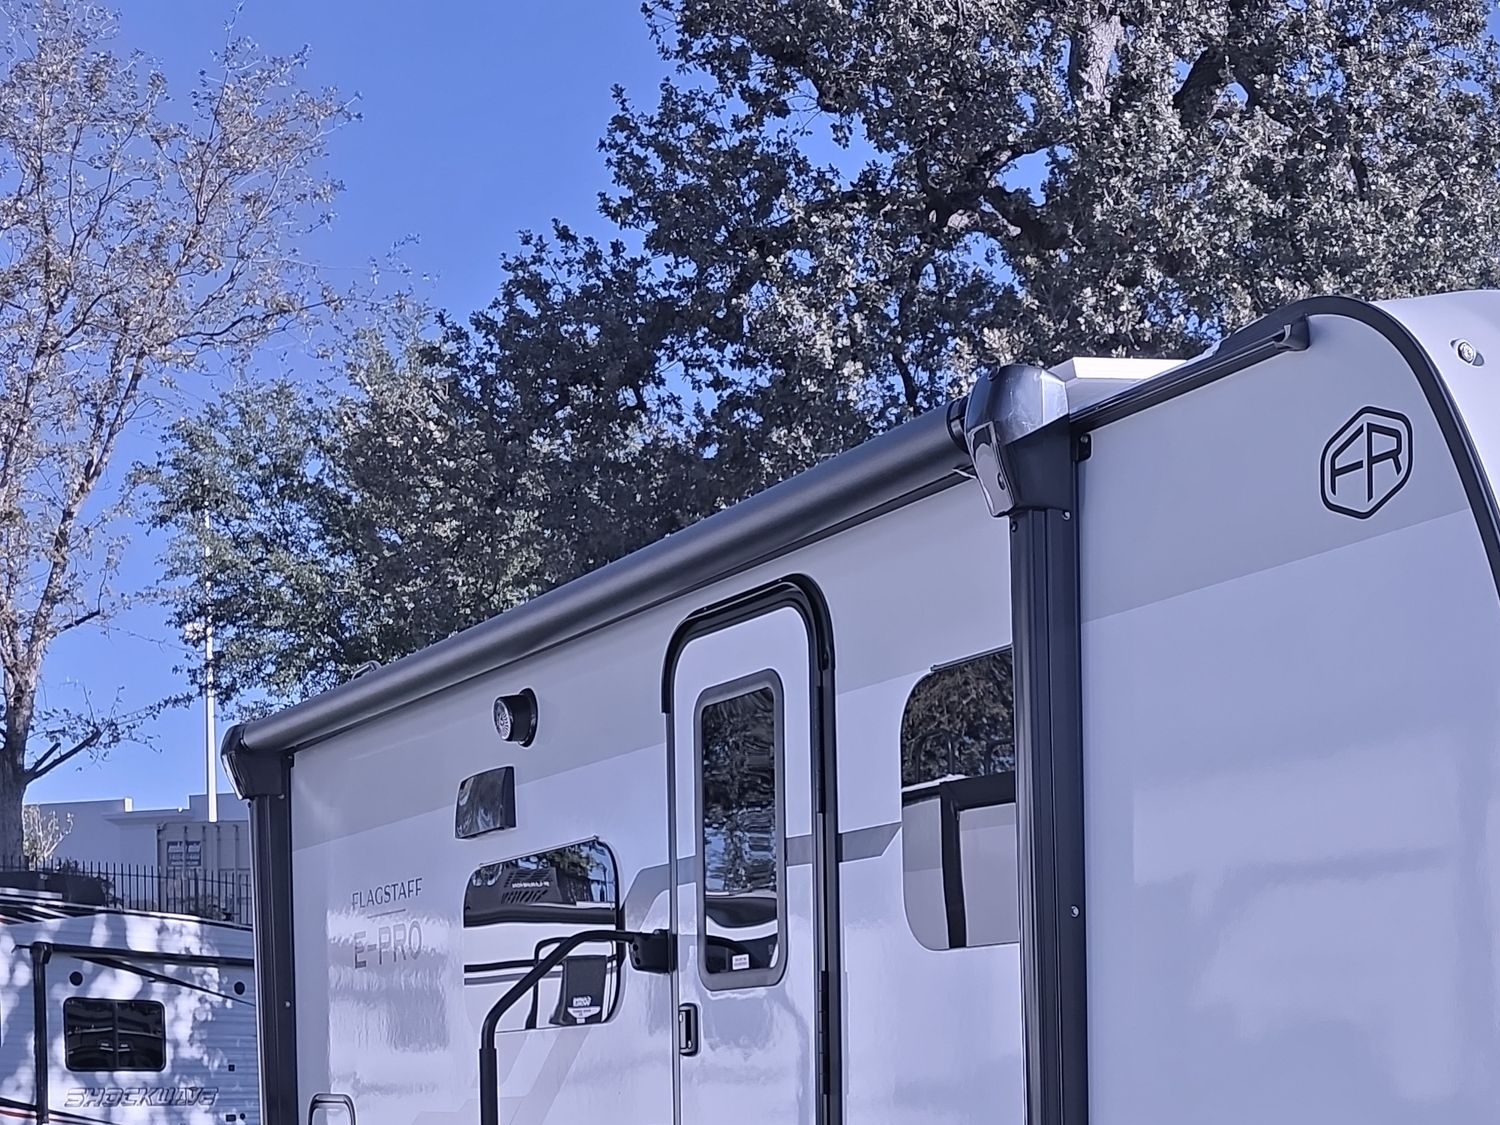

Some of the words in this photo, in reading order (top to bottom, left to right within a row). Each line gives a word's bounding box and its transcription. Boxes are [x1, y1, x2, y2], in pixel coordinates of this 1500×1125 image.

[352, 877, 423, 910] FLAGSTAFF
[354, 920, 423, 969] E-PRO
[64, 1086, 219, 1108] SHOCKWAVE
